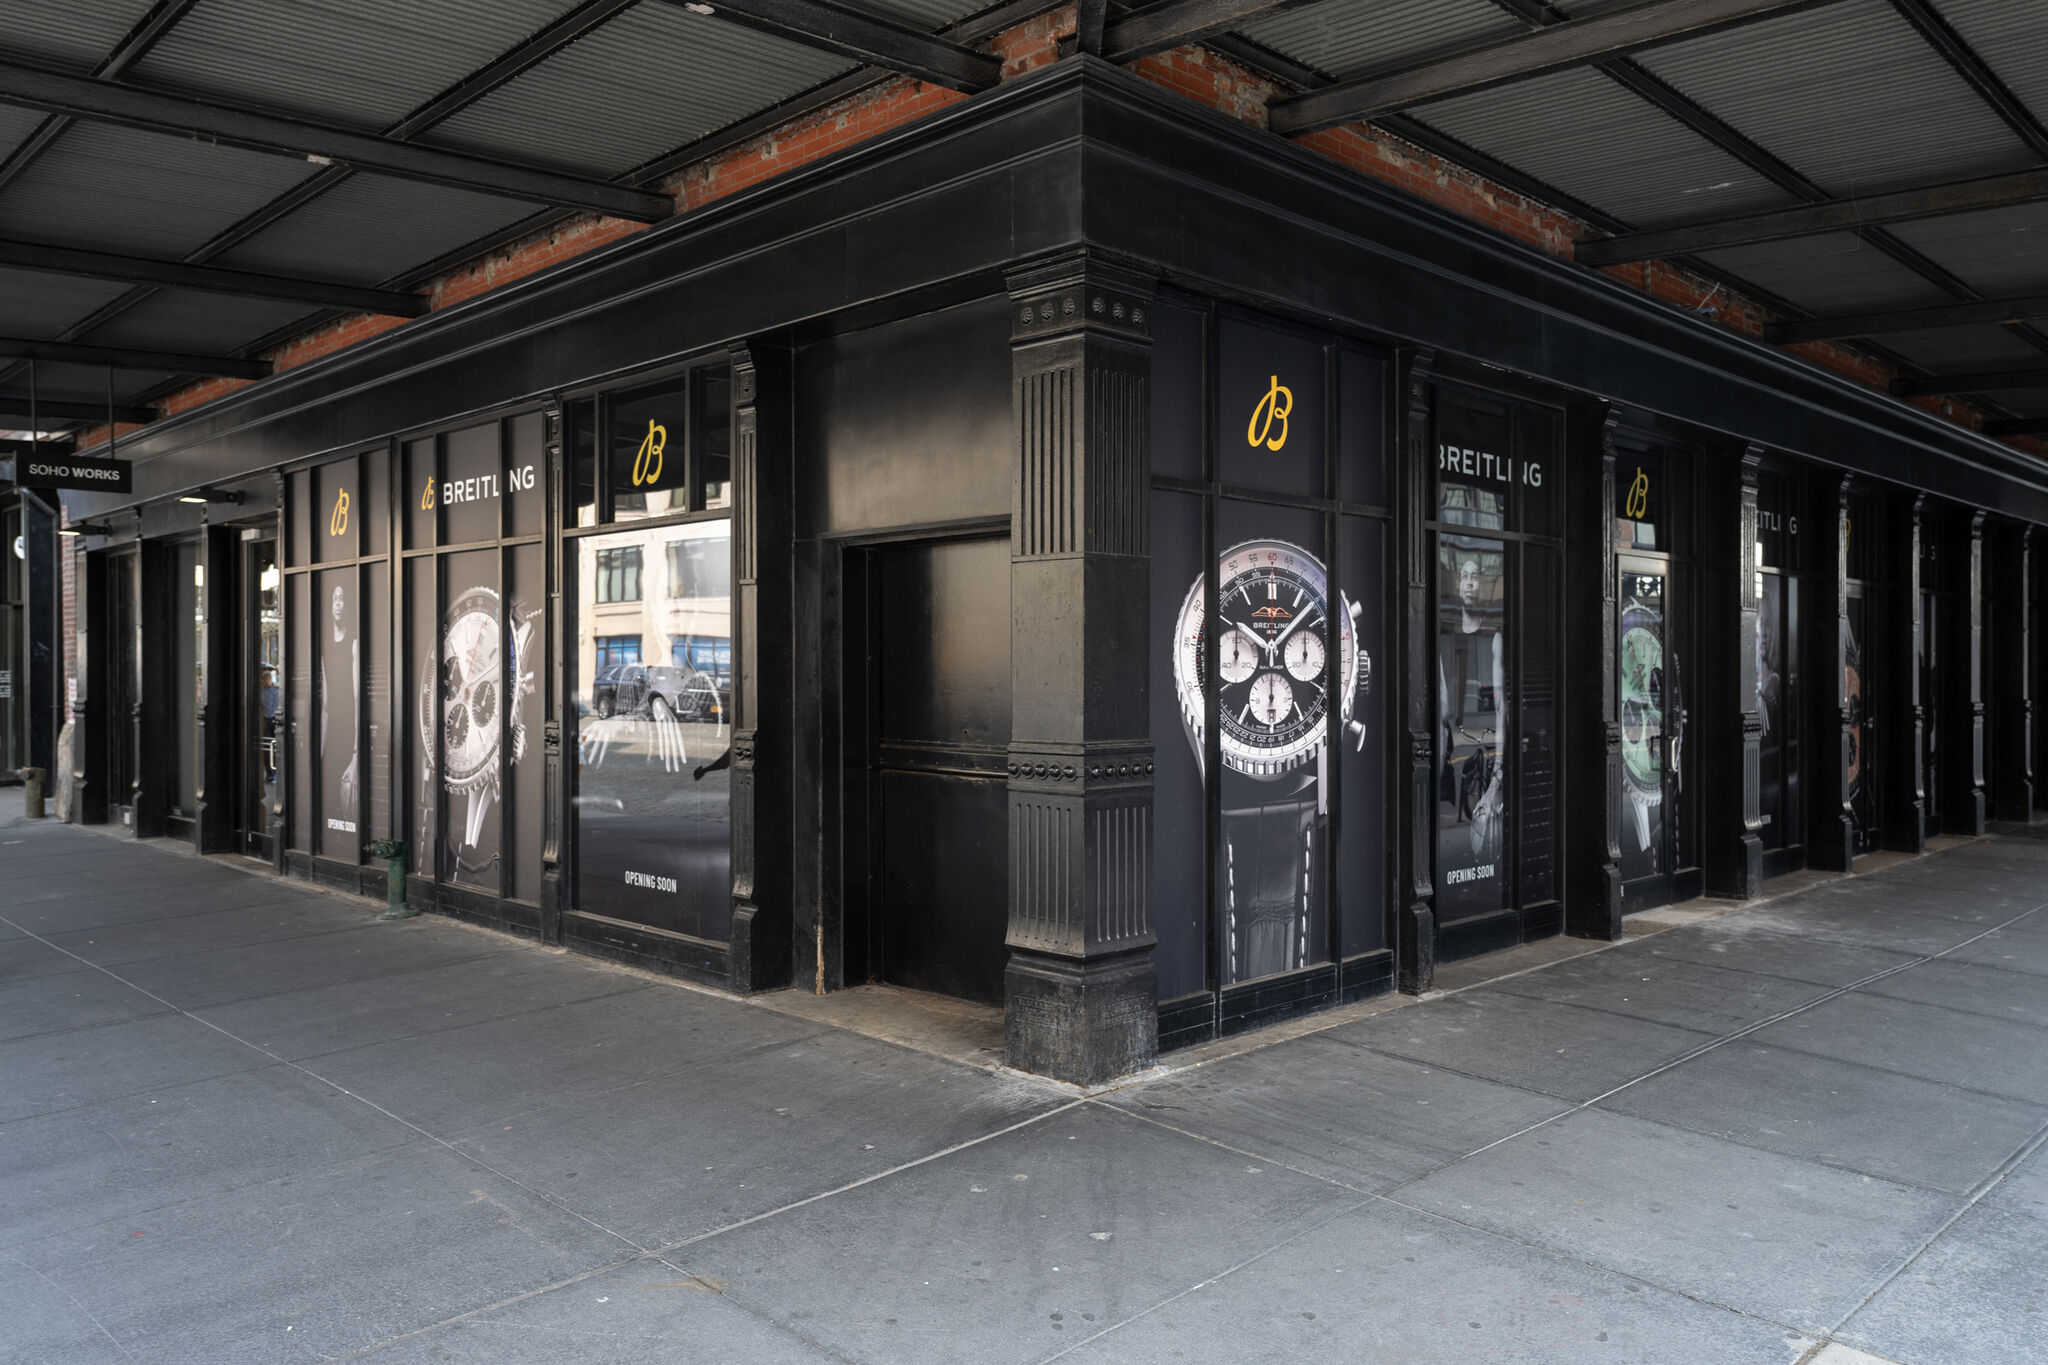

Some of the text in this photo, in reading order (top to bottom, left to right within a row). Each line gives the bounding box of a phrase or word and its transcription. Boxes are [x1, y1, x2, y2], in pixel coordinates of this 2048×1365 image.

[29, 463, 120, 481] SOHO WORKS
[443, 464, 535, 505] BREITLNG
[625, 870, 677, 893] OPENING SOON
[1446, 864, 1494, 885] OPENING SOON
